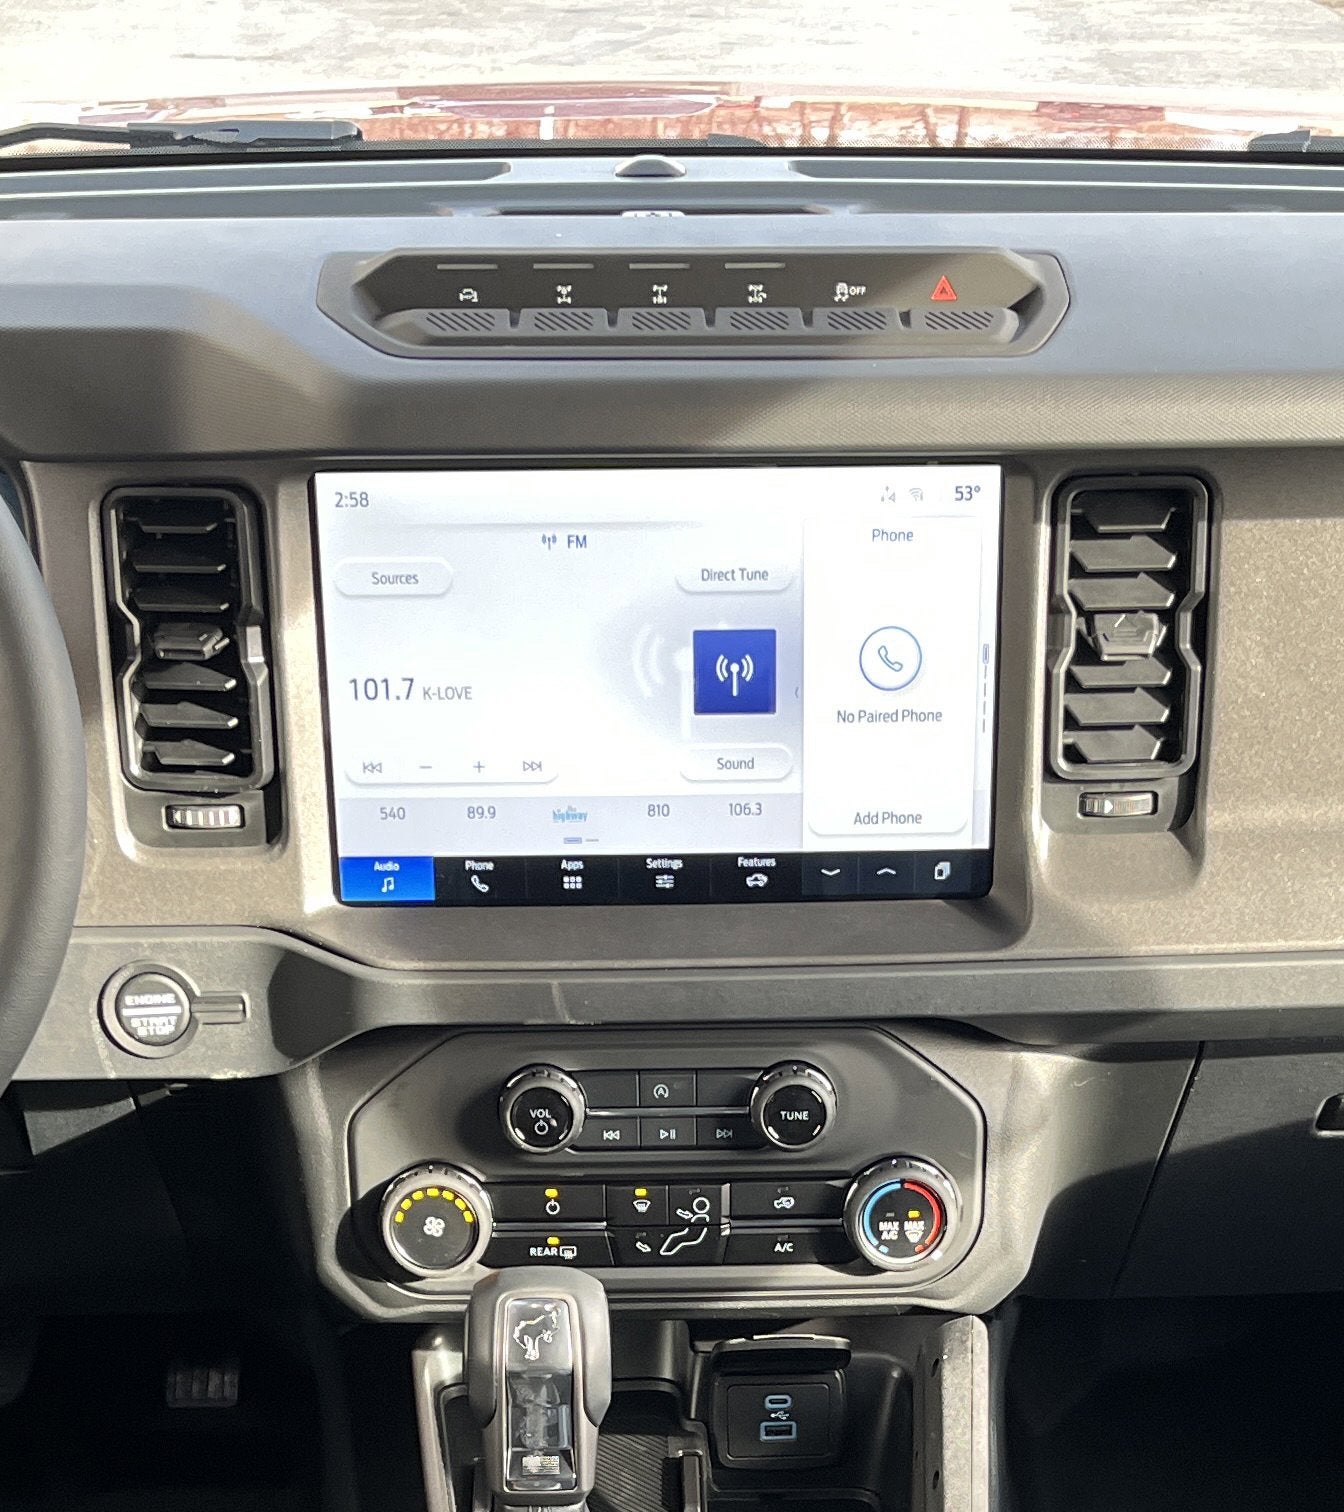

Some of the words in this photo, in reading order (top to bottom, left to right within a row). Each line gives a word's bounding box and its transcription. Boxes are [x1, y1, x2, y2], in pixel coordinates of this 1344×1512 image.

[849, 286, 866, 296] OFF
[334, 491, 369, 508] 2:58
[567, 535, 587, 549] FM
[872, 529, 914, 542] Phone
[371, 571, 419, 586] Sources
[701, 568, 736, 582] Direct
[739, 567, 769, 581] Tune
[349, 678, 415, 701] 101.7
[422, 686, 472, 701] K-LOVE
[837, 710, 855, 723] No
[858, 709, 899, 723] Paired
[901, 709, 943, 722] Phone
[717, 757, 755, 770] Sound
[379, 806, 406, 821] 540
[467, 806, 496, 820] 89.9
[647, 804, 670, 818] 810
[728, 802, 763, 816] 106.3
[854, 811, 879, 825] Add
[882, 811, 923, 825] Phone
[374, 860, 400, 872] Audio
[465, 859, 494, 871] Phone
[561, 859, 584, 871] Apps
[646, 857, 683, 871] Settings
[737, 856, 776, 868] Features
[125, 993, 176, 1006] ENGINE
[529, 1108, 552, 1119] VOL
[780, 1111, 810, 1121] TUNE
[879, 1221, 900, 1231] MAX
[903, 1221, 925, 1231] MAX
[881, 1231, 899, 1240] A/C
[529, 1247, 558, 1257] REAR
[774, 1242, 794, 1253] A/C
